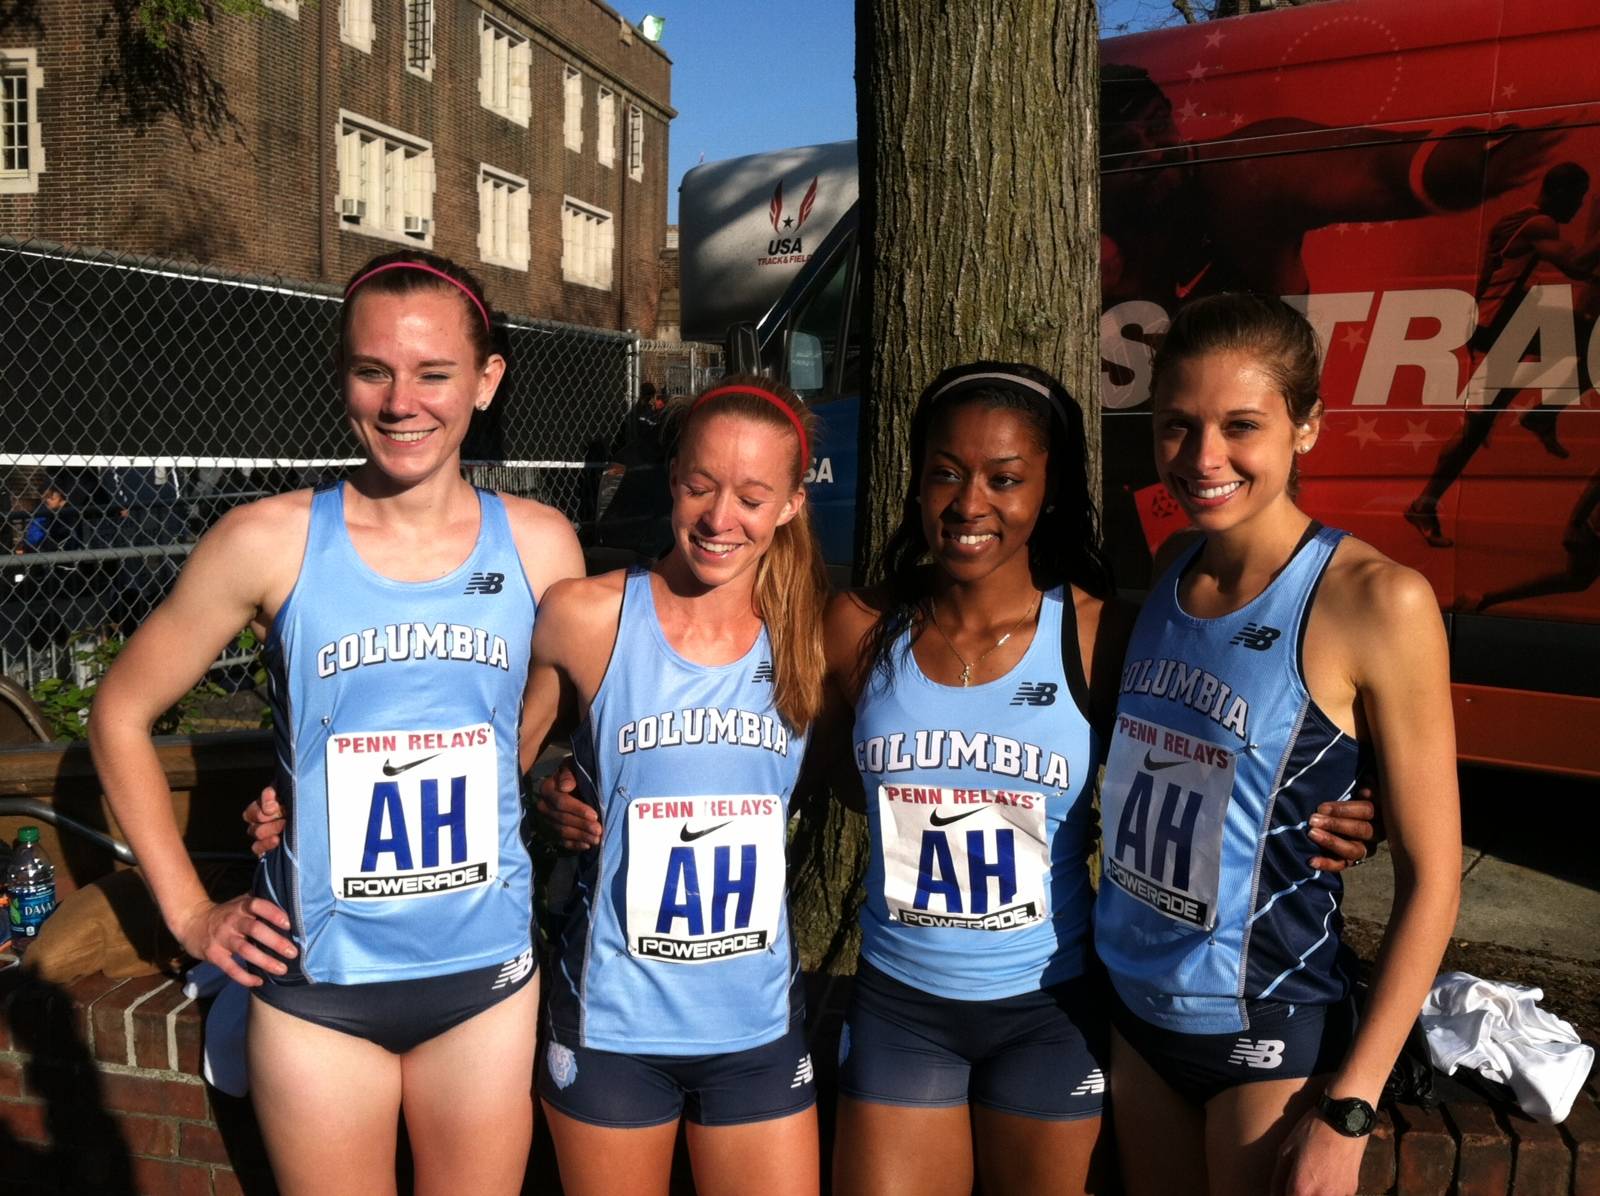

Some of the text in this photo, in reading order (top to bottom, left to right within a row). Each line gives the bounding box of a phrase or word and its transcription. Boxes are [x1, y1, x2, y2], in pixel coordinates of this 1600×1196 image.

[758, 257, 783, 266] TRACK
[768, 237, 802, 256] USA
[1280, 284, 1600, 406] TRA
[803, 457, 834, 483] SA
[316, 621, 509, 679] COLUMBIA
[337, 728, 488, 754] PENN RELAYS
[617, 706, 789, 757] COLUMBIA
[1118, 716, 1228, 769] PENN RELAYS
[855, 729, 1070, 790] COLUMBIA
[360, 775, 468, 873] AH
[638, 801, 694, 819] PENN
[888, 786, 1035, 809] PENN RELAYS
[1114, 770, 1204, 892] AH
[655, 844, 757, 936] AH
[913, 828, 1017, 914] AH
